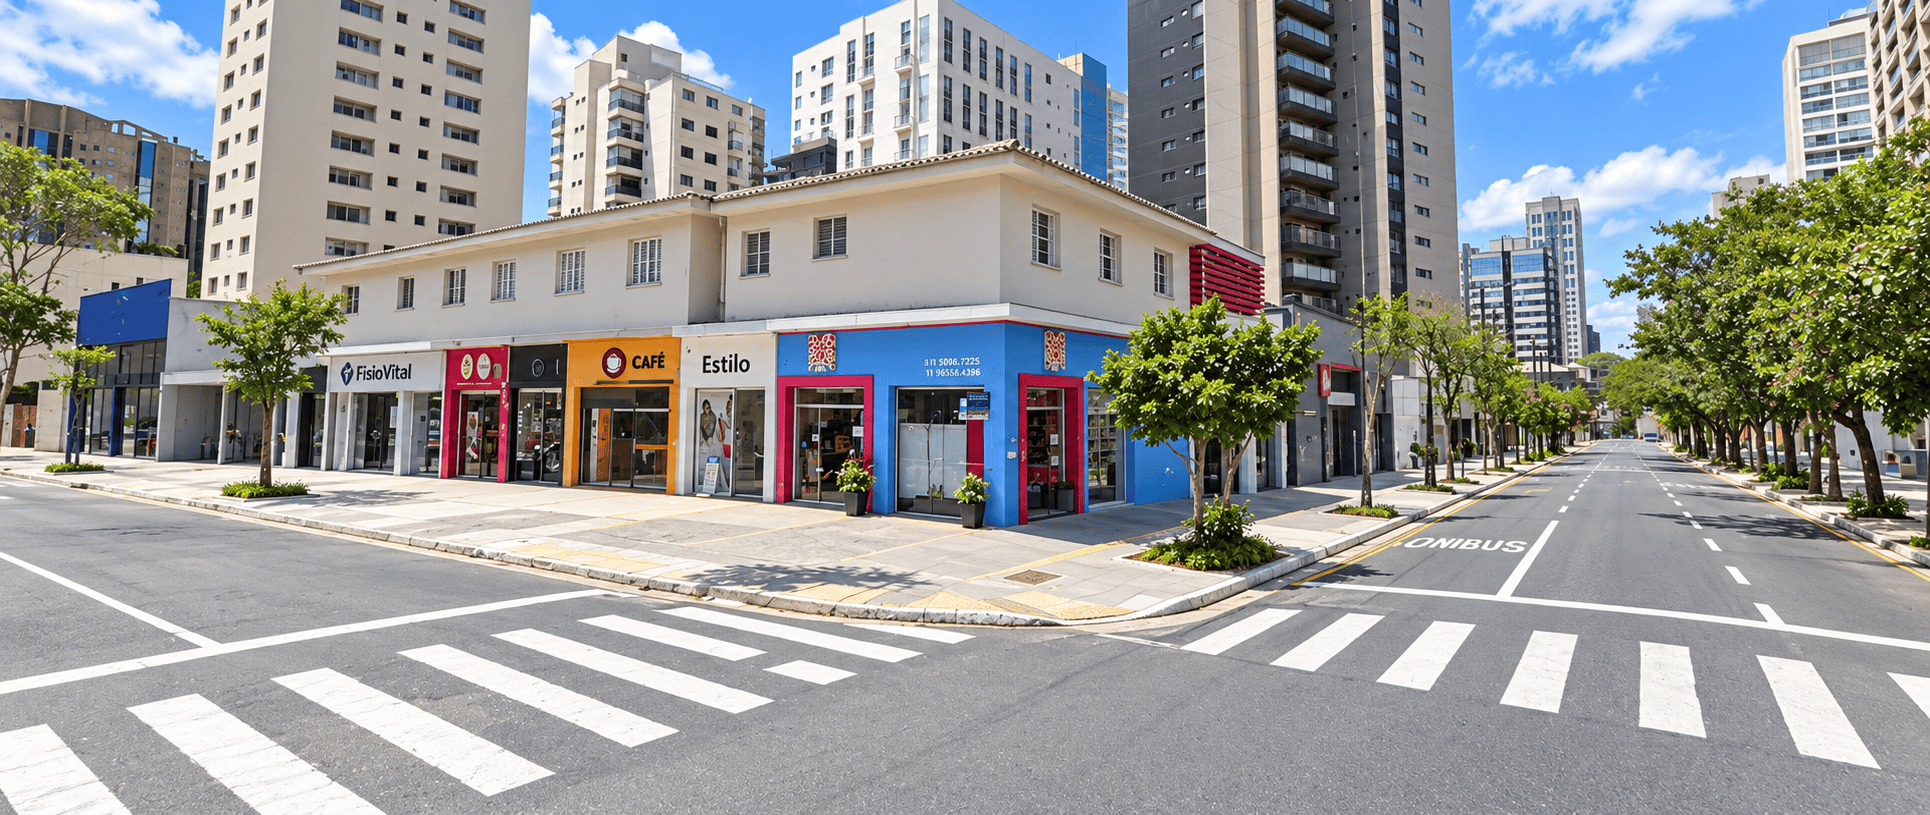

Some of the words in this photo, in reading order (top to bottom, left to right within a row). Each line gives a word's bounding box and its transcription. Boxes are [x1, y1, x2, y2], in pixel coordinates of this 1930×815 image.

[631, 350, 665, 370] CAFÉ
[702, 353, 751, 374] Estilo
[356, 363, 412, 381] FisioVital
[1403, 537, 1528, 553] ONIBUS
